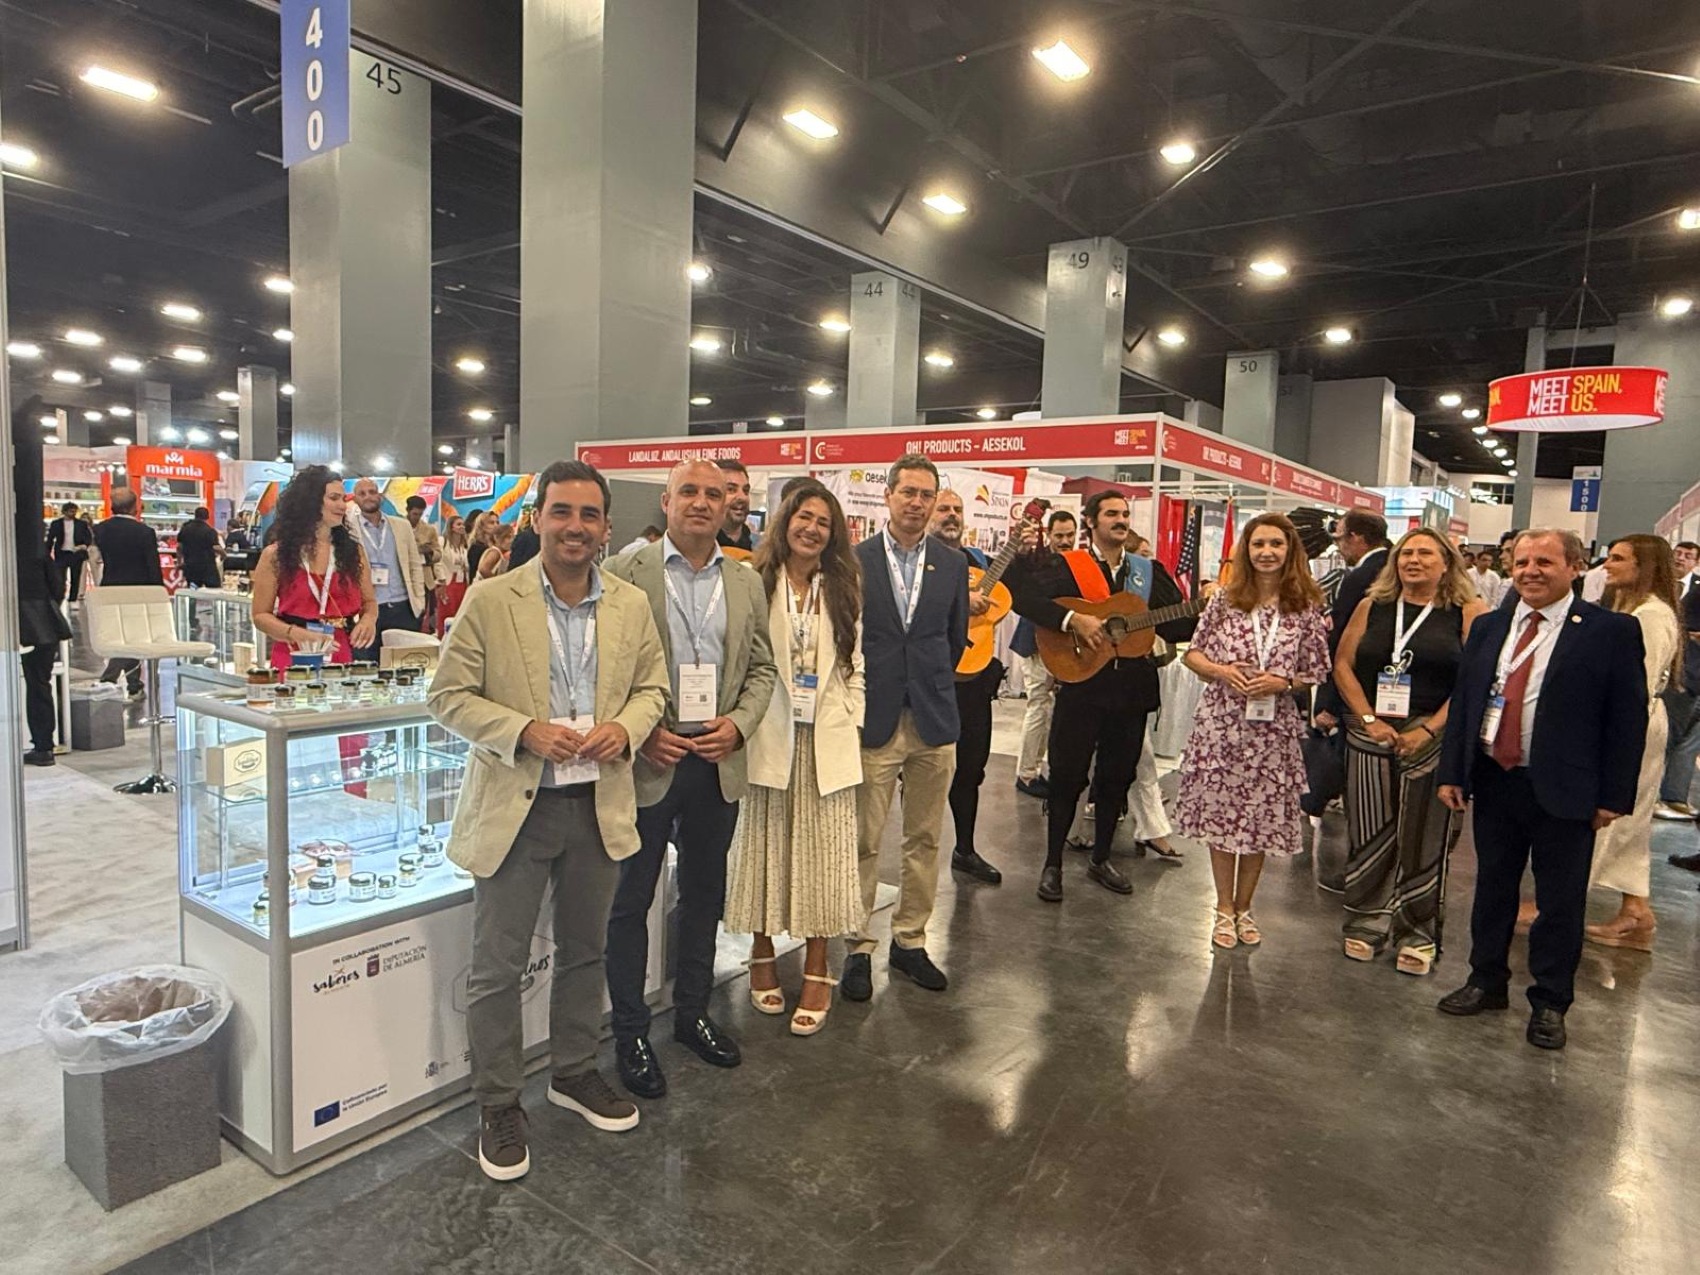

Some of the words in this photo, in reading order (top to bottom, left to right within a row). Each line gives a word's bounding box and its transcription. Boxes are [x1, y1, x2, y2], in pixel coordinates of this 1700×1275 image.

[305, 7, 324, 152] 400
[366, 62, 402, 95] 45
[1067, 251, 1090, 270] 49
[864, 281, 884, 298] 44
[1239, 360, 1258, 374] 50
[1529, 376, 1571, 399] MEET
[1572, 373, 1623, 395] SPAIN,
[1527, 395, 1569, 416] MEET
[1570, 393, 1598, 412] US.
[718, 446, 741, 460] FOODS
[906, 441, 922, 454] OH!
[923, 438, 972, 454] PRODUCTS
[982, 436, 1026, 452] AESEKOL
[145, 463, 203, 477] marmia
[1580, 480, 1590, 512] 1500
[341, 941, 393, 962] COLLABORATION
